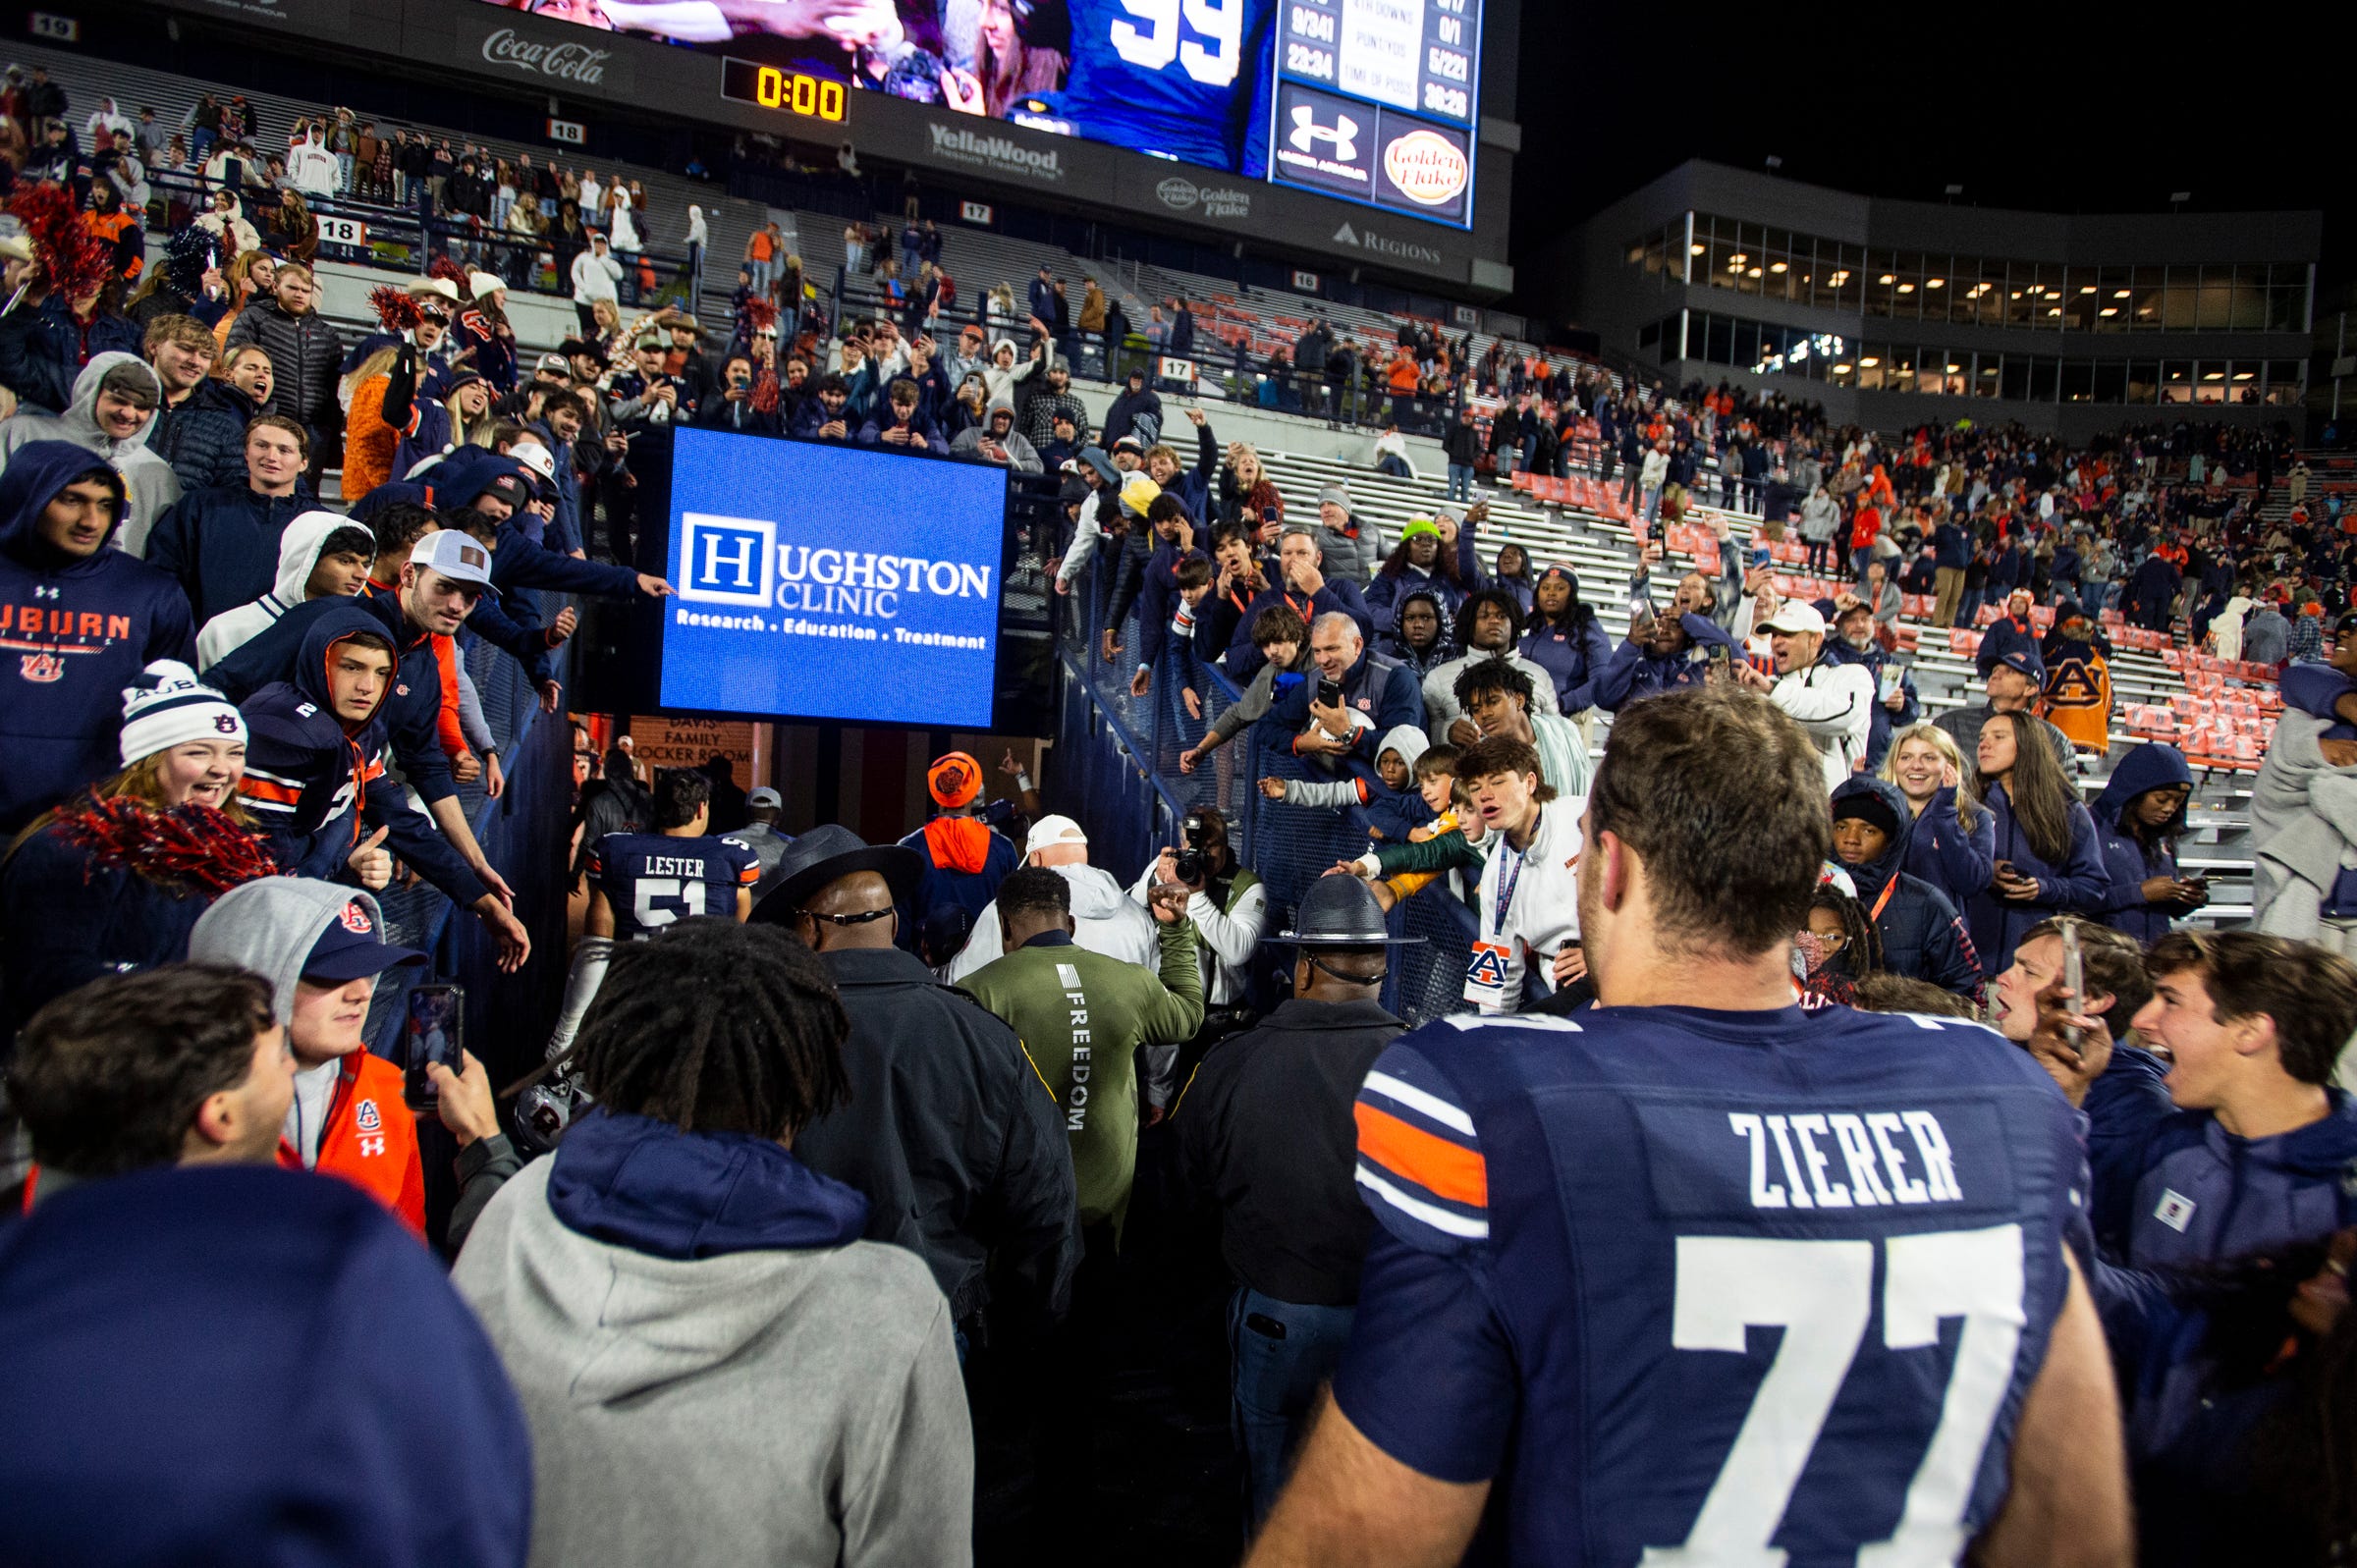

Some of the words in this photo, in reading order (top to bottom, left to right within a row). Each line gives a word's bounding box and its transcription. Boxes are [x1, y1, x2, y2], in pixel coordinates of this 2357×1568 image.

[39, 18, 69, 35] 19
[482, 28, 611, 84] Coca-Cola
[757, 66, 844, 122] 0:00
[555, 124, 578, 140] 18
[929, 122, 1058, 171] YellaWood
[1393, 144, 1461, 171] Golden
[1401, 168, 1457, 187] Flake
[1199, 188, 1249, 205] Golden
[966, 203, 986, 219] 17
[1205, 201, 1249, 218] Flake
[322, 219, 355, 242] 18
[1296, 274, 1315, 287] 16
[1458, 308, 1474, 322] 15
[1166, 359, 1187, 376] 17
[776, 581, 898, 619] CLINIC
[0, 604, 131, 640] UBURN
[677, 609, 765, 632] Research
[784, 618, 877, 641] Education
[894, 627, 987, 650] Treatment
[296, 702, 317, 719] 2
[665, 731, 721, 746] FAMILY
[645, 856, 704, 877] LESTER
[634, 879, 706, 927] 51
[1067, 993, 1091, 1130] FREEDOM
[1728, 1110, 1963, 1209] ZIERER
[1636, 1223, 2028, 1568] 77
